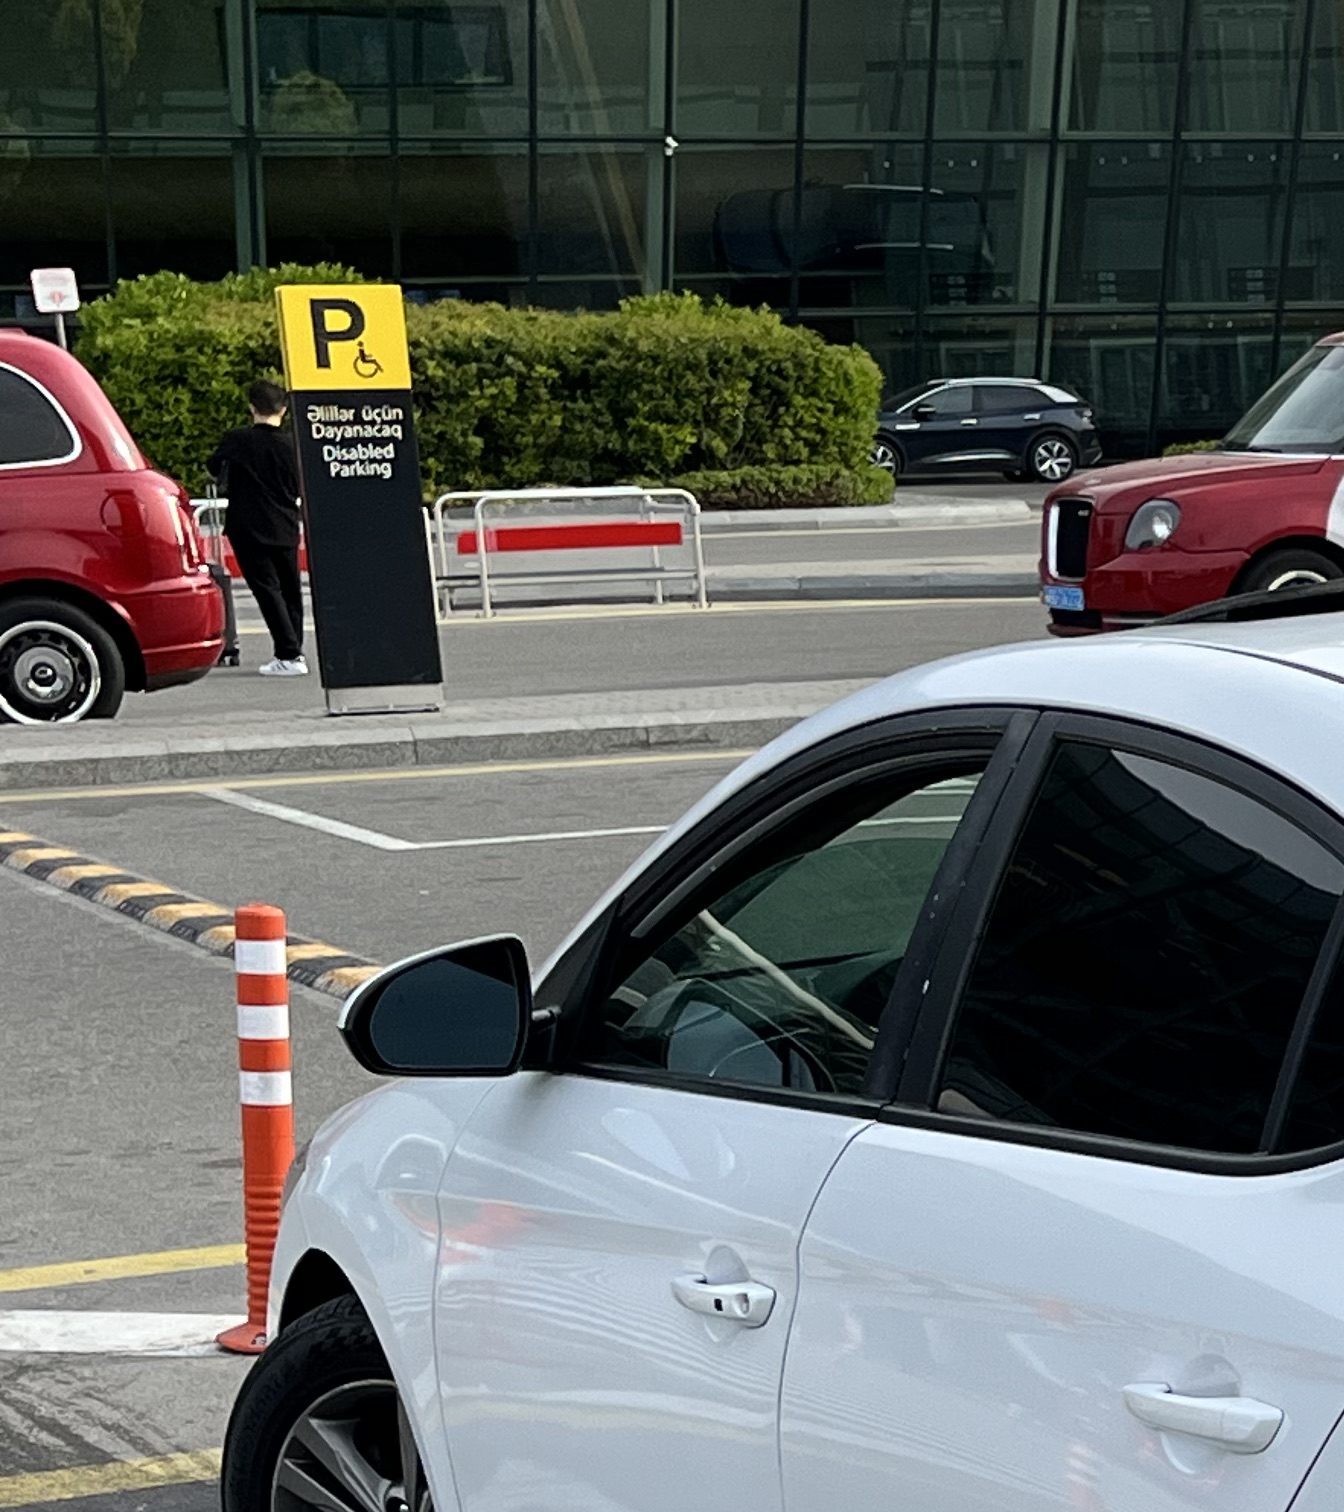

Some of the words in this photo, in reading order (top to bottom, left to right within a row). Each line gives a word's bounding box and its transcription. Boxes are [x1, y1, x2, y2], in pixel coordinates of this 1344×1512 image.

[310, 298, 366, 369] P
[311, 423, 403, 442] Dayanacaq
[323, 443, 395, 462] Disabled
[330, 461, 392, 479] Parking
